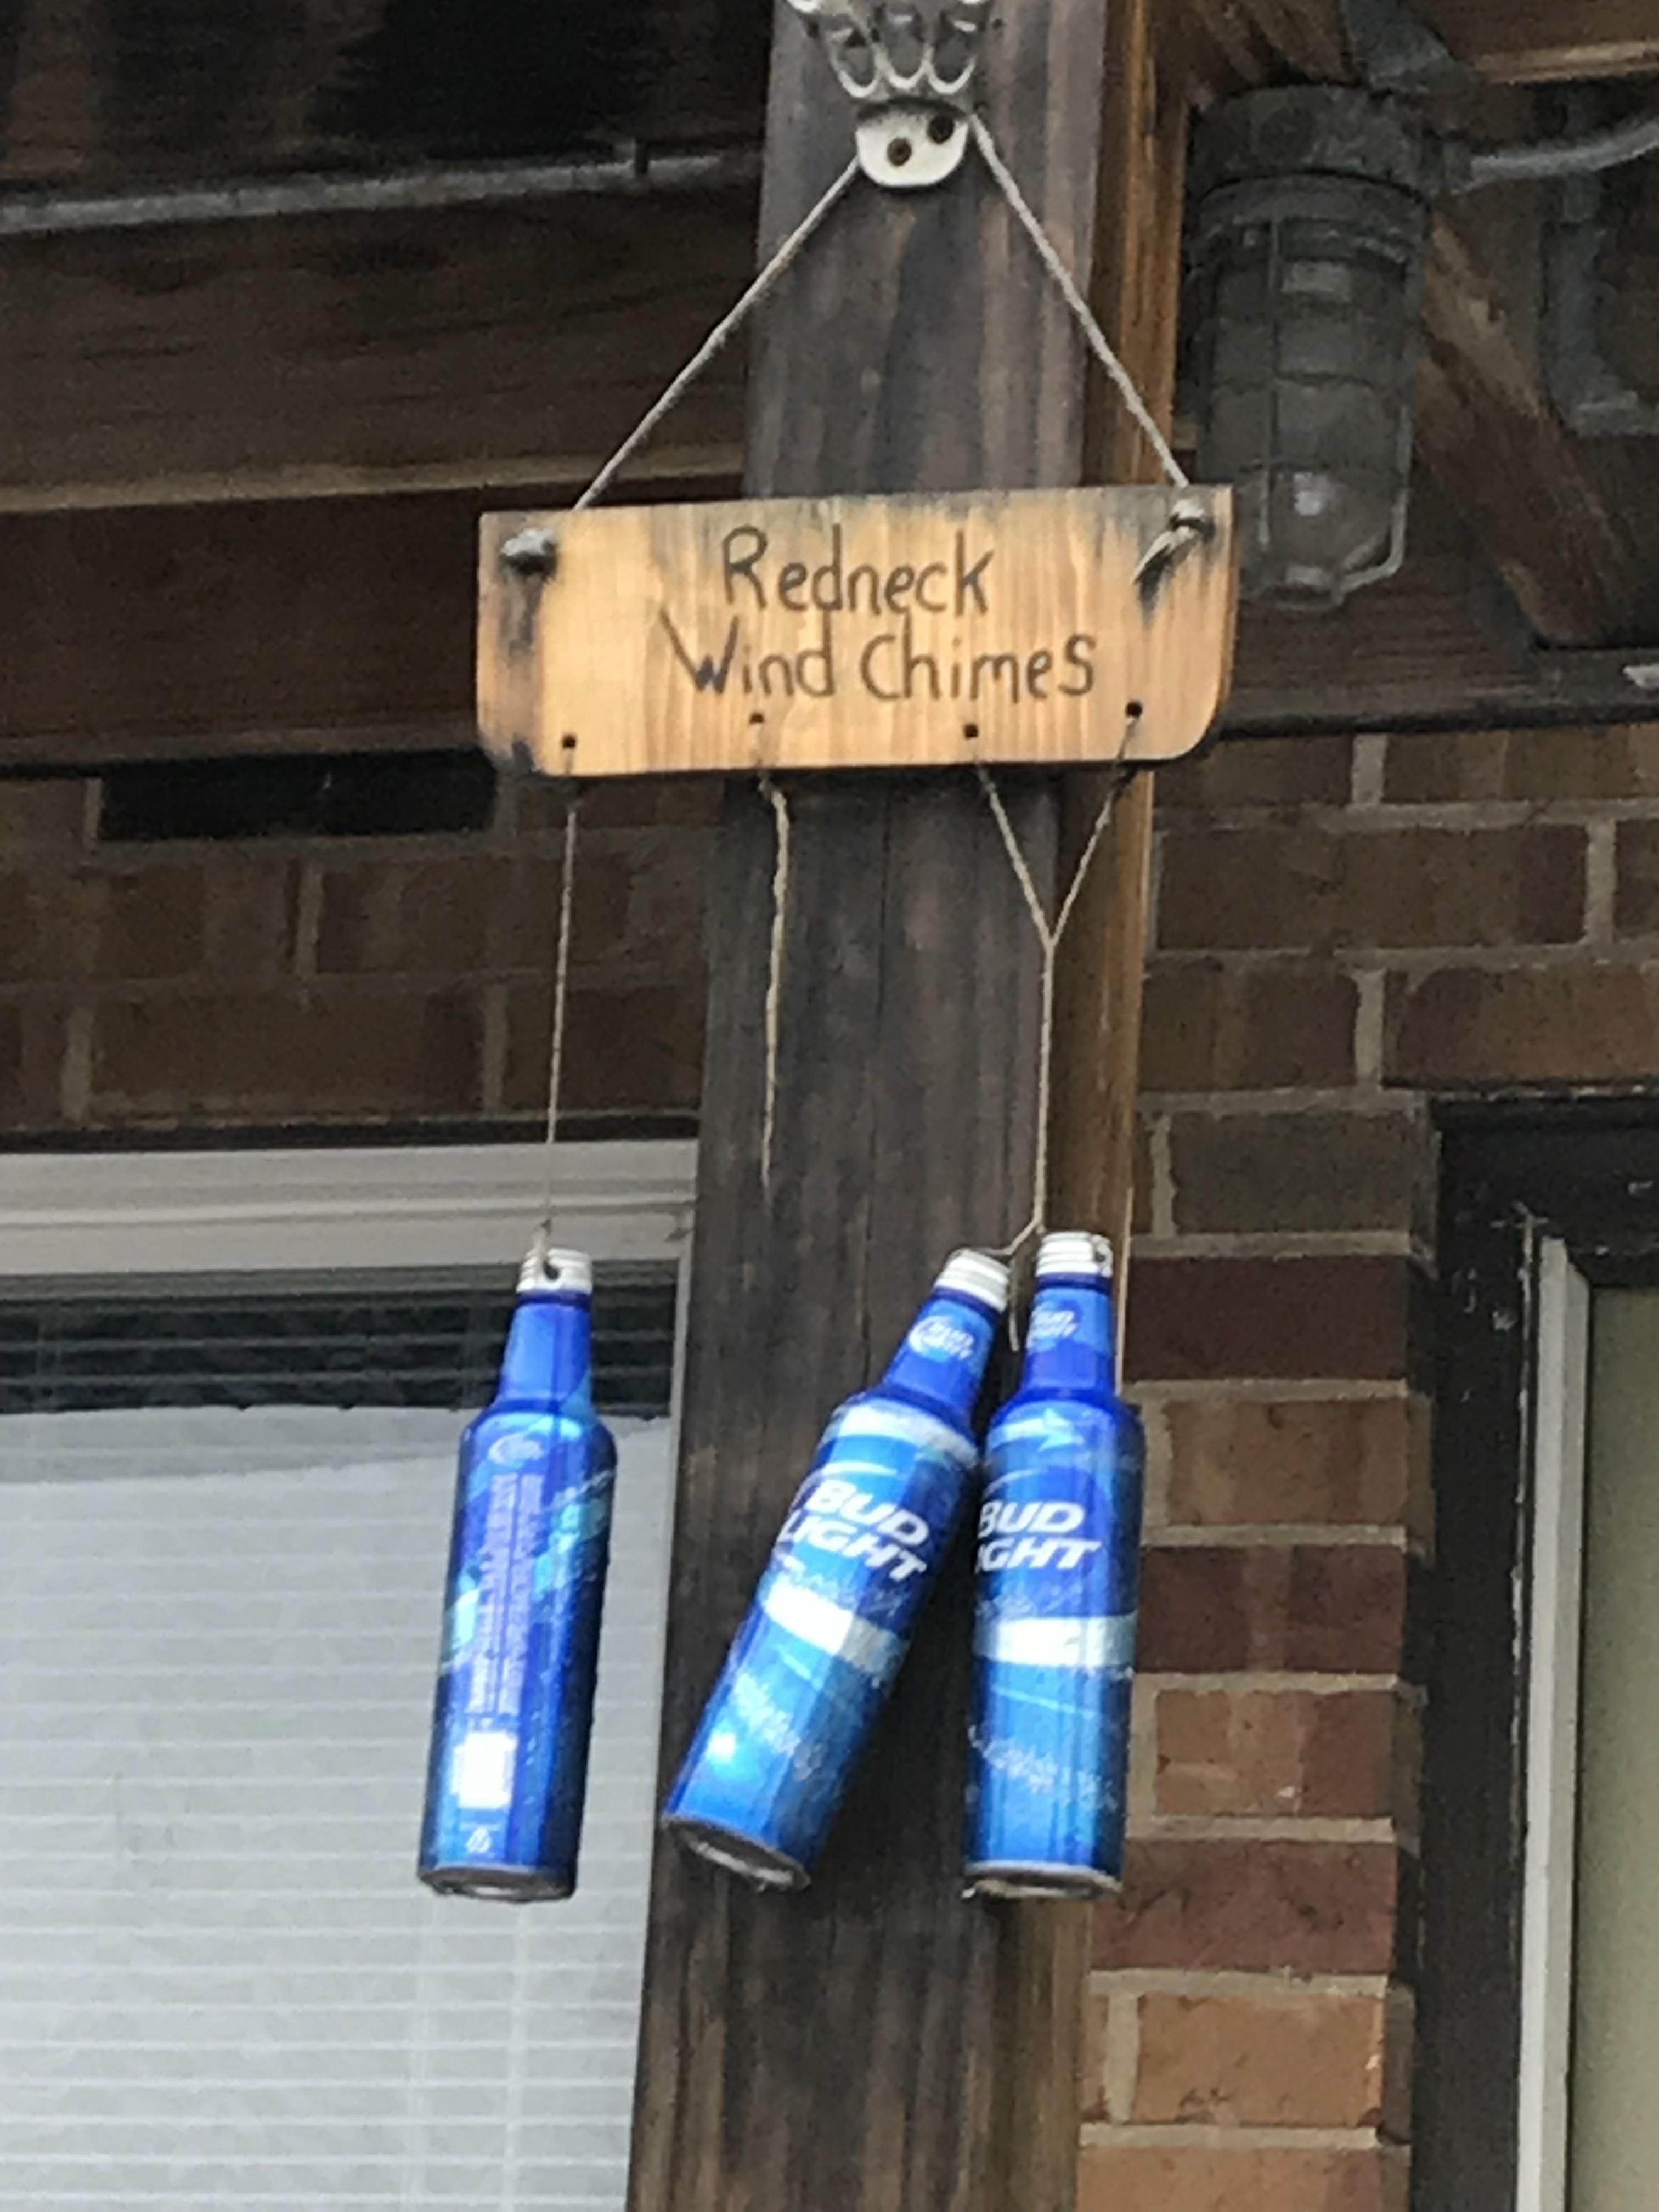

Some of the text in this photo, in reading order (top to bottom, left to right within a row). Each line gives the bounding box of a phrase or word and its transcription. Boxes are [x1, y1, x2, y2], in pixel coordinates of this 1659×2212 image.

[721, 523, 994, 617] Redneck
[660, 609, 1097, 704] Wind Chimes
[776, 1510, 927, 1582] LIGHT
[804, 1480, 929, 1546] BUD
[978, 1501, 1086, 1538] BUD
